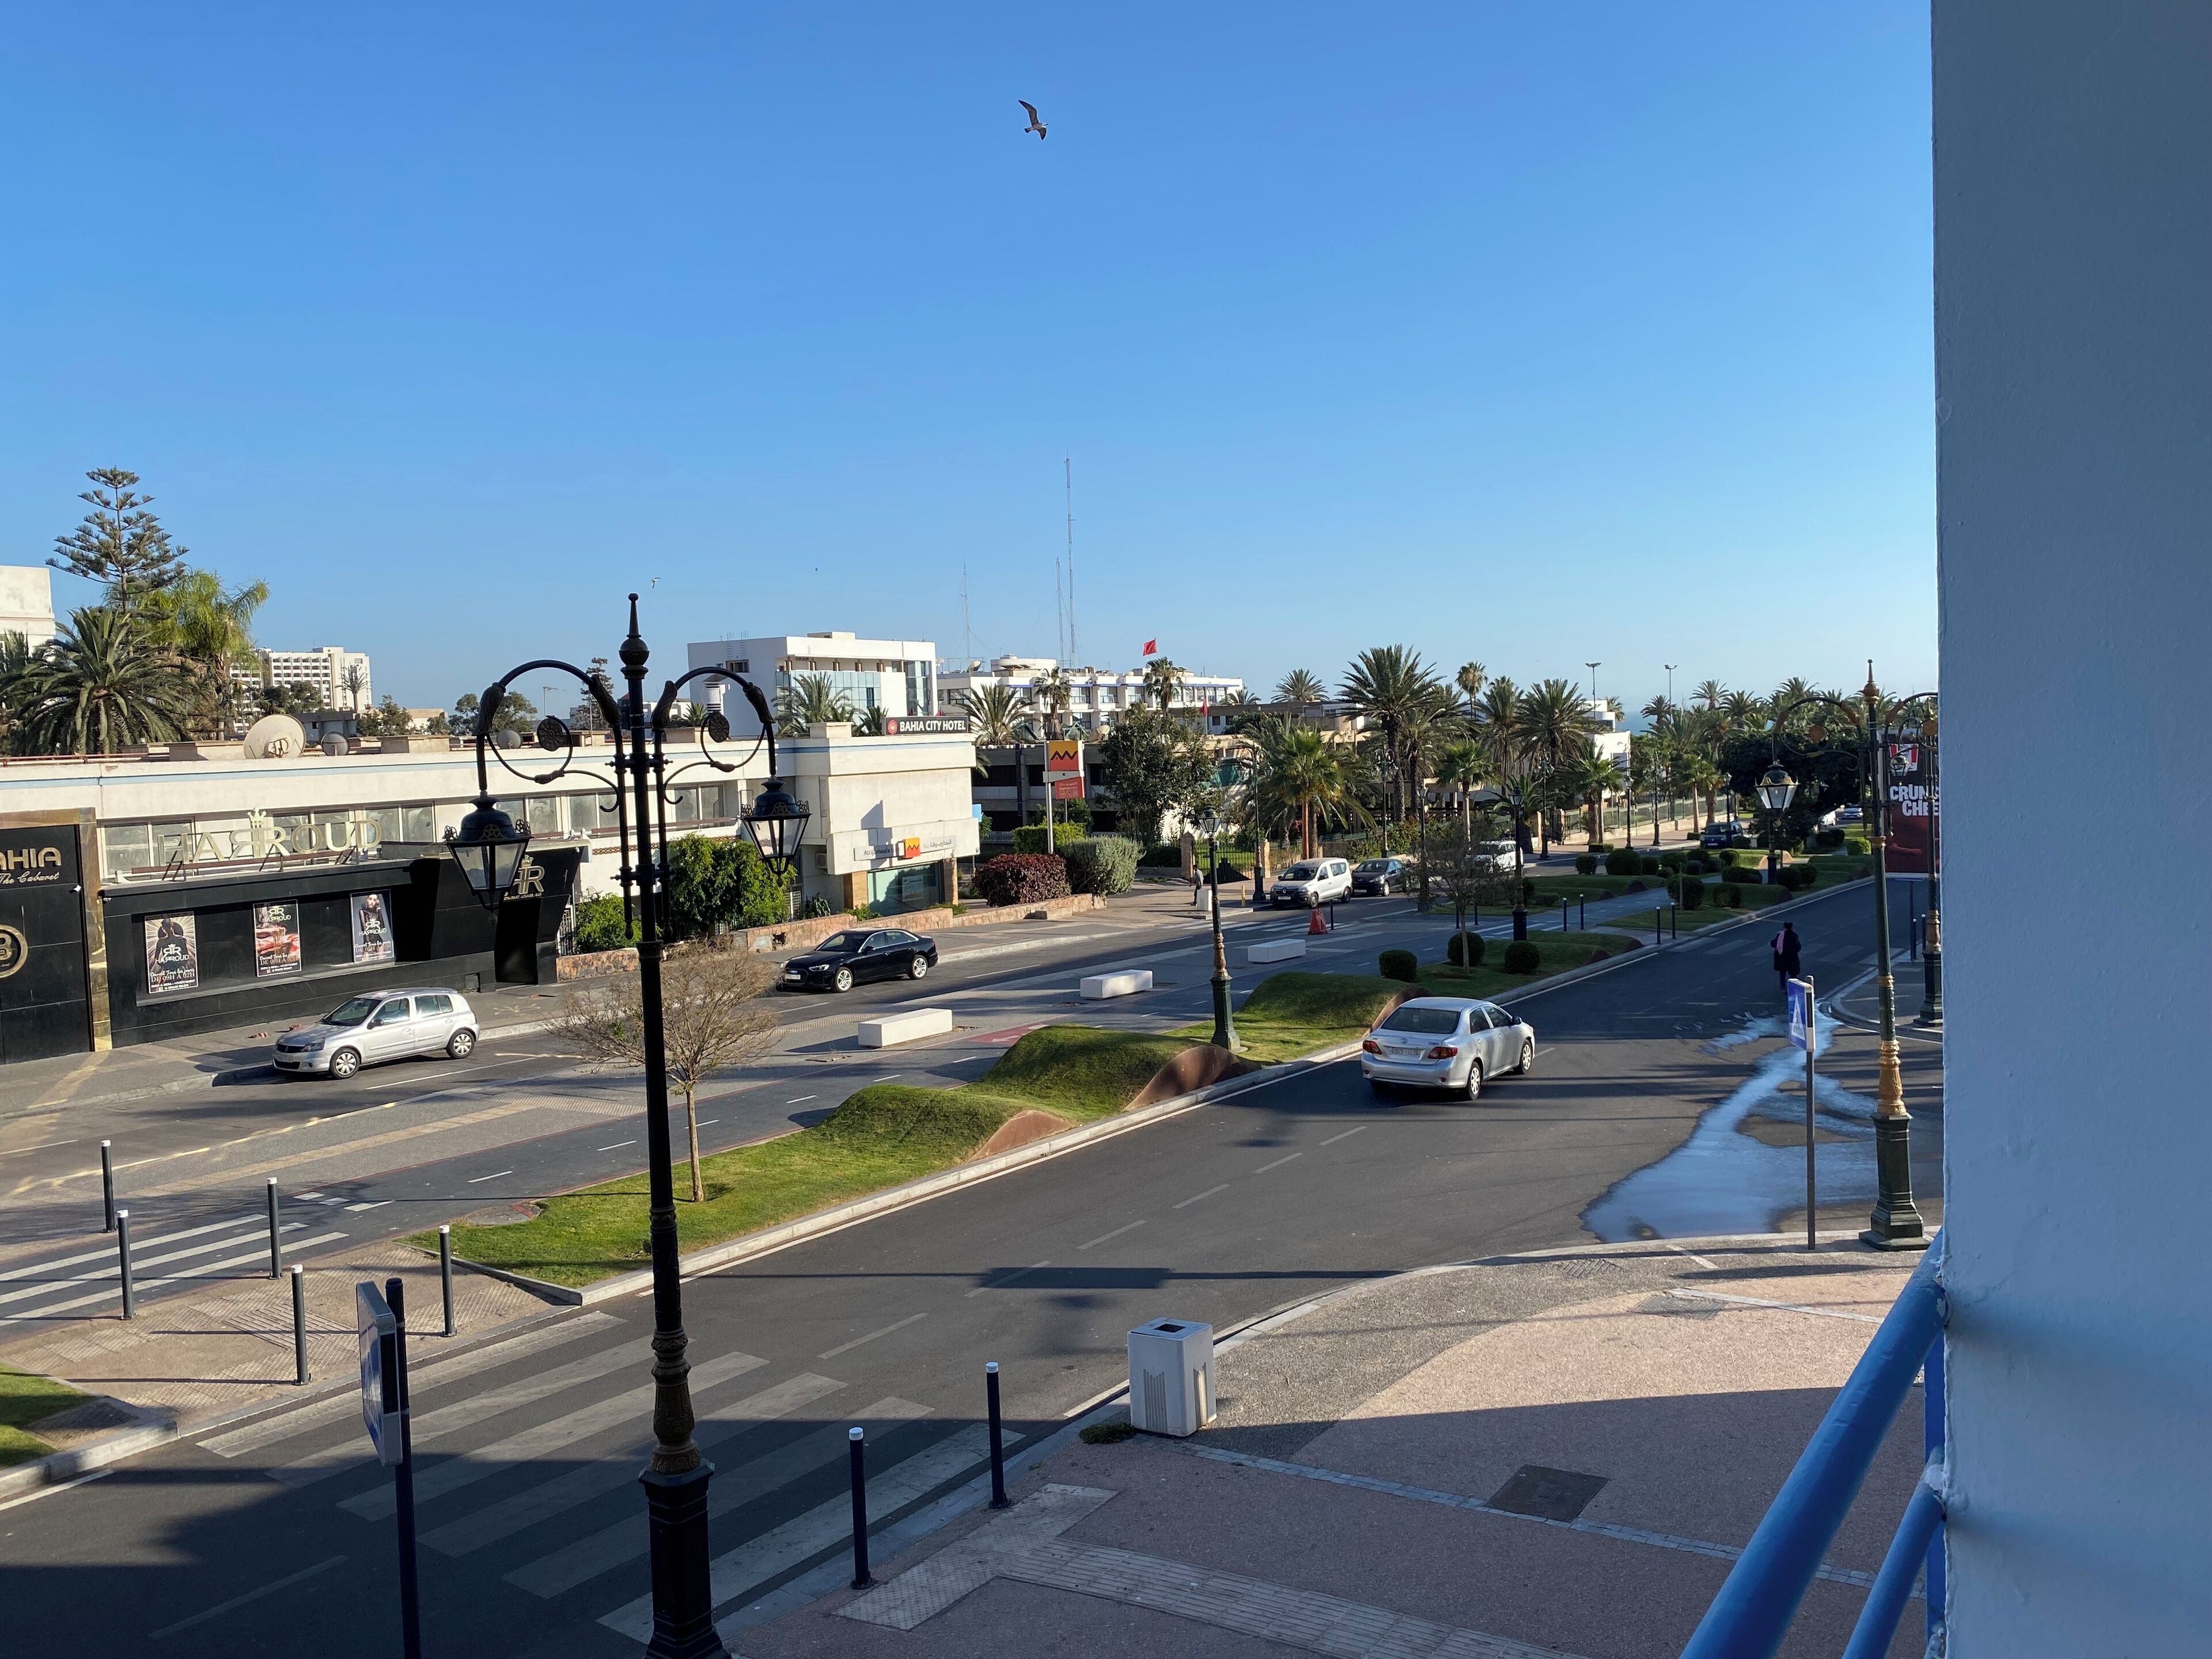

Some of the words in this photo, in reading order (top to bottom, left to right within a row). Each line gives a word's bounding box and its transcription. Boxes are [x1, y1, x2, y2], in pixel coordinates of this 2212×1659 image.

[900, 721, 925, 732] BAHIA
[925, 721, 942, 731] CITY
[942, 720, 966, 730] HOTEL
[0, 847, 62, 870] HIA
[17, 870, 59, 883] Cabaret
